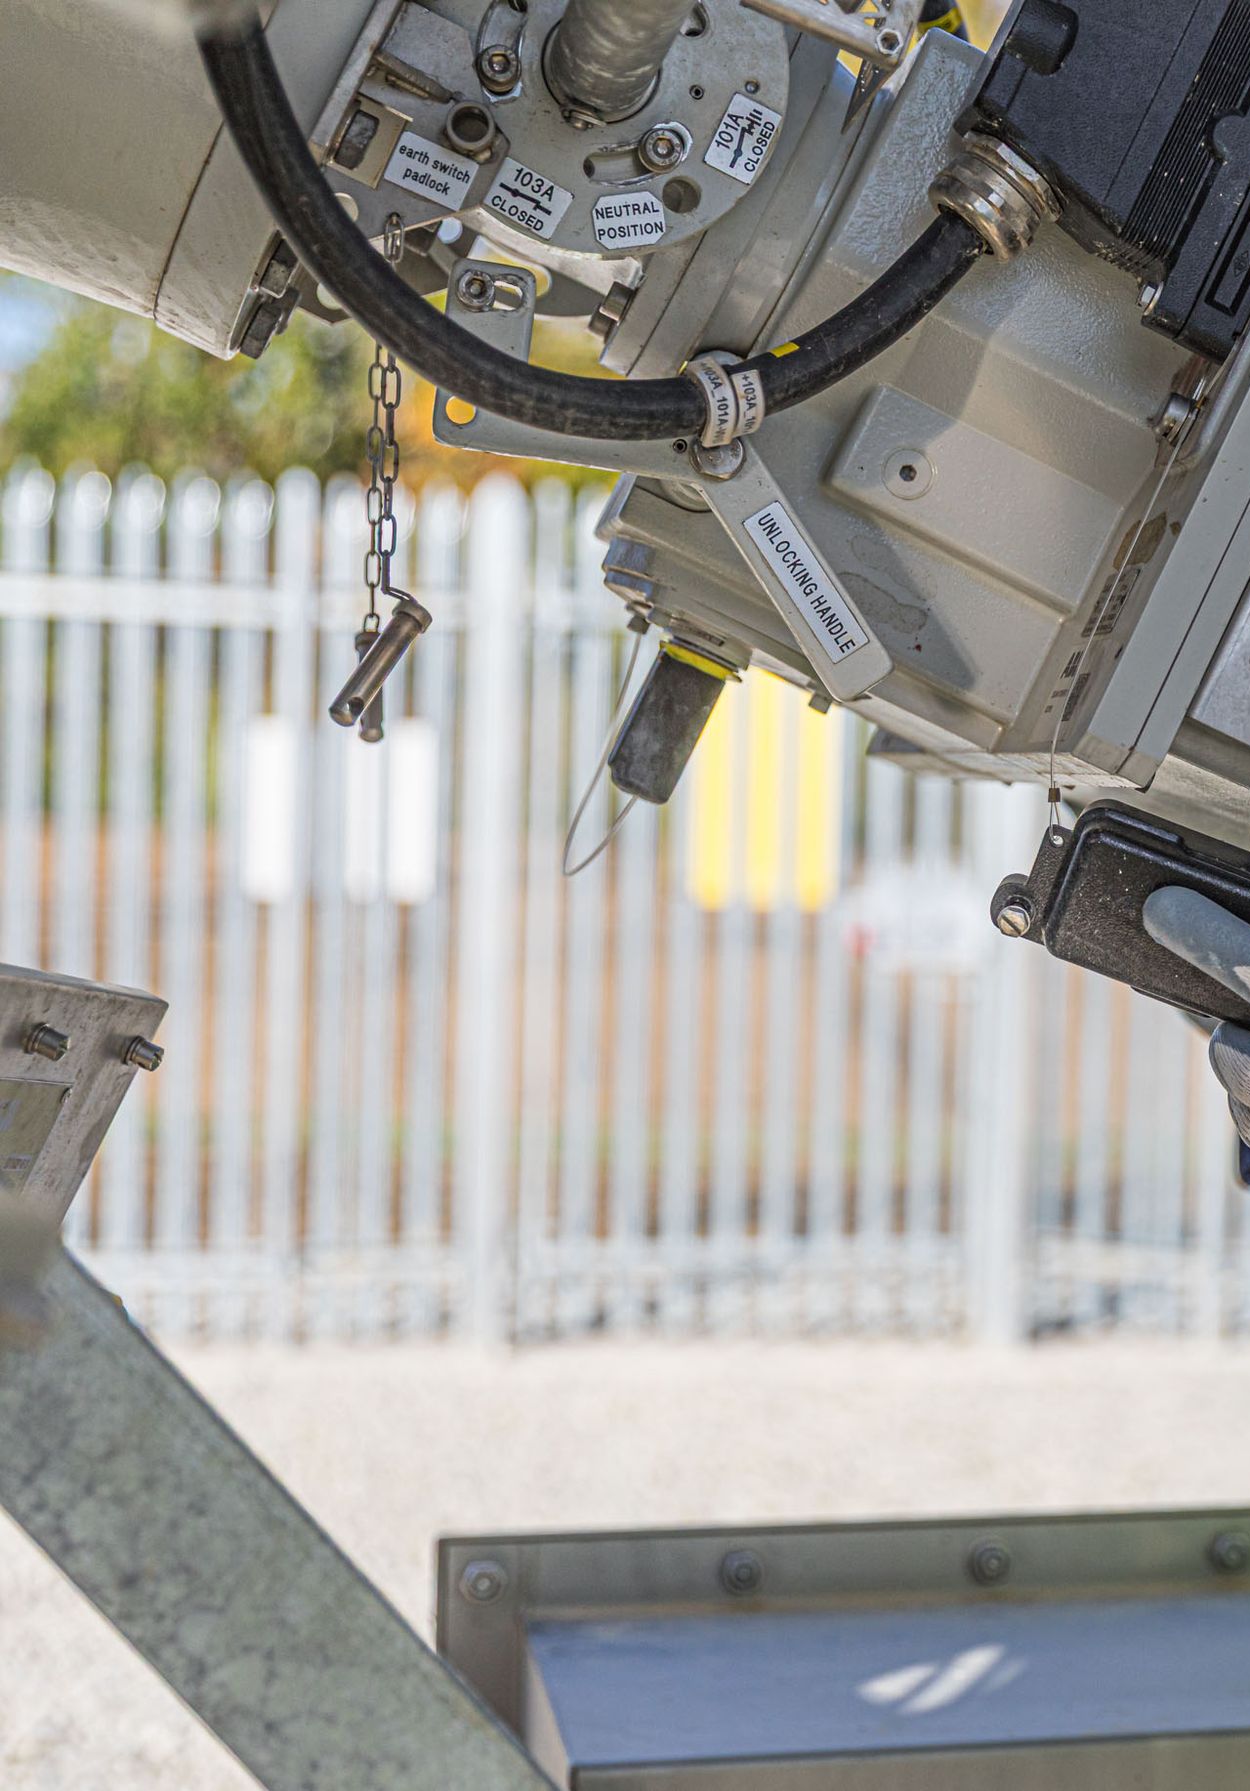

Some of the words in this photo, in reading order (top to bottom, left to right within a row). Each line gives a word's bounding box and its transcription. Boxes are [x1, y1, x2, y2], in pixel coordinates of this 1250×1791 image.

[714, 112, 744, 149] 101A
[743, 120, 775, 172] CLOSED
[399, 143, 430, 166] earth
[431, 157, 470, 184] switch
[402, 166, 450, 196] padlock
[514, 167, 555, 202] 103A
[491, 195, 544, 232] CLOSED
[595, 201, 660, 220] NEUTRAL
[597, 221, 664, 240] POSITION
[758, 513, 818, 597] UNLOCKING
[810, 594, 855, 653] HANDLE
